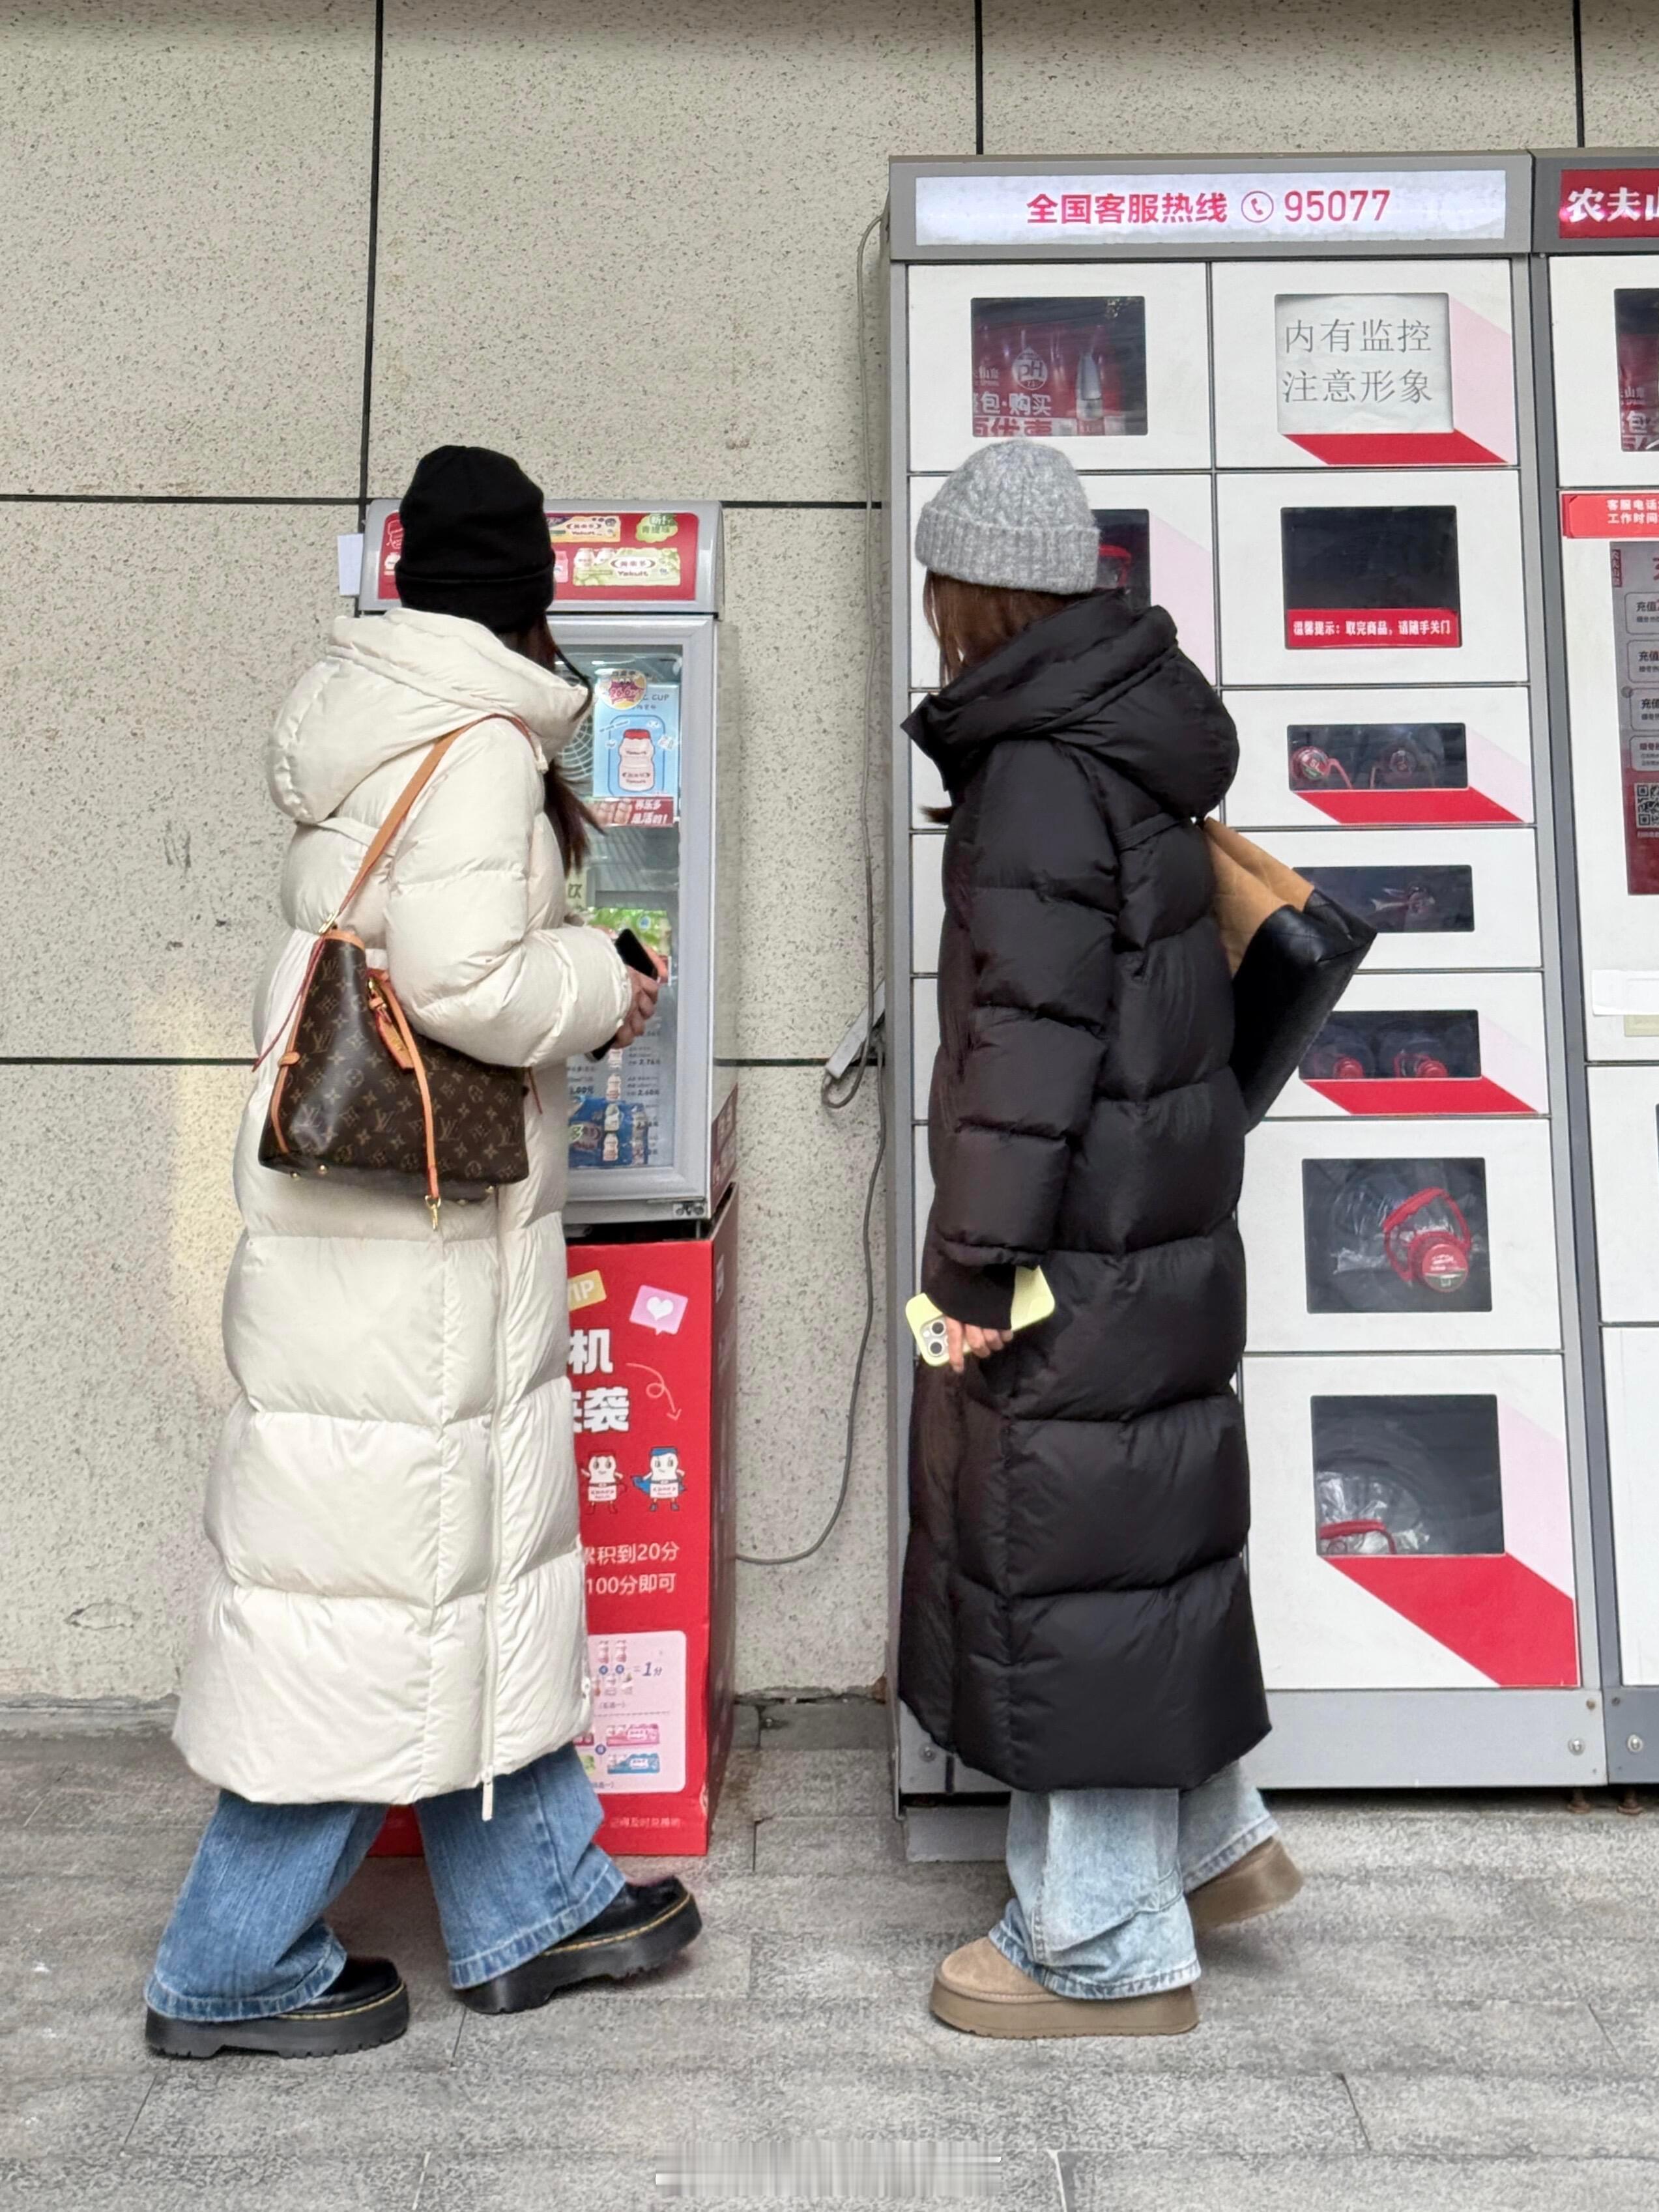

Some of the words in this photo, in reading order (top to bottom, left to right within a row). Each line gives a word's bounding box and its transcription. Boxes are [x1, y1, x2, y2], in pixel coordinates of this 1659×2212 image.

[1026, 193, 1228, 224] 全国客服热线
[1284, 190, 1391, 222] 95077
[1286, 319, 1432, 354] 内有监控
[1282, 368, 1432, 403] 注意形象
[974, 392, 1052, 416] 包·购买
